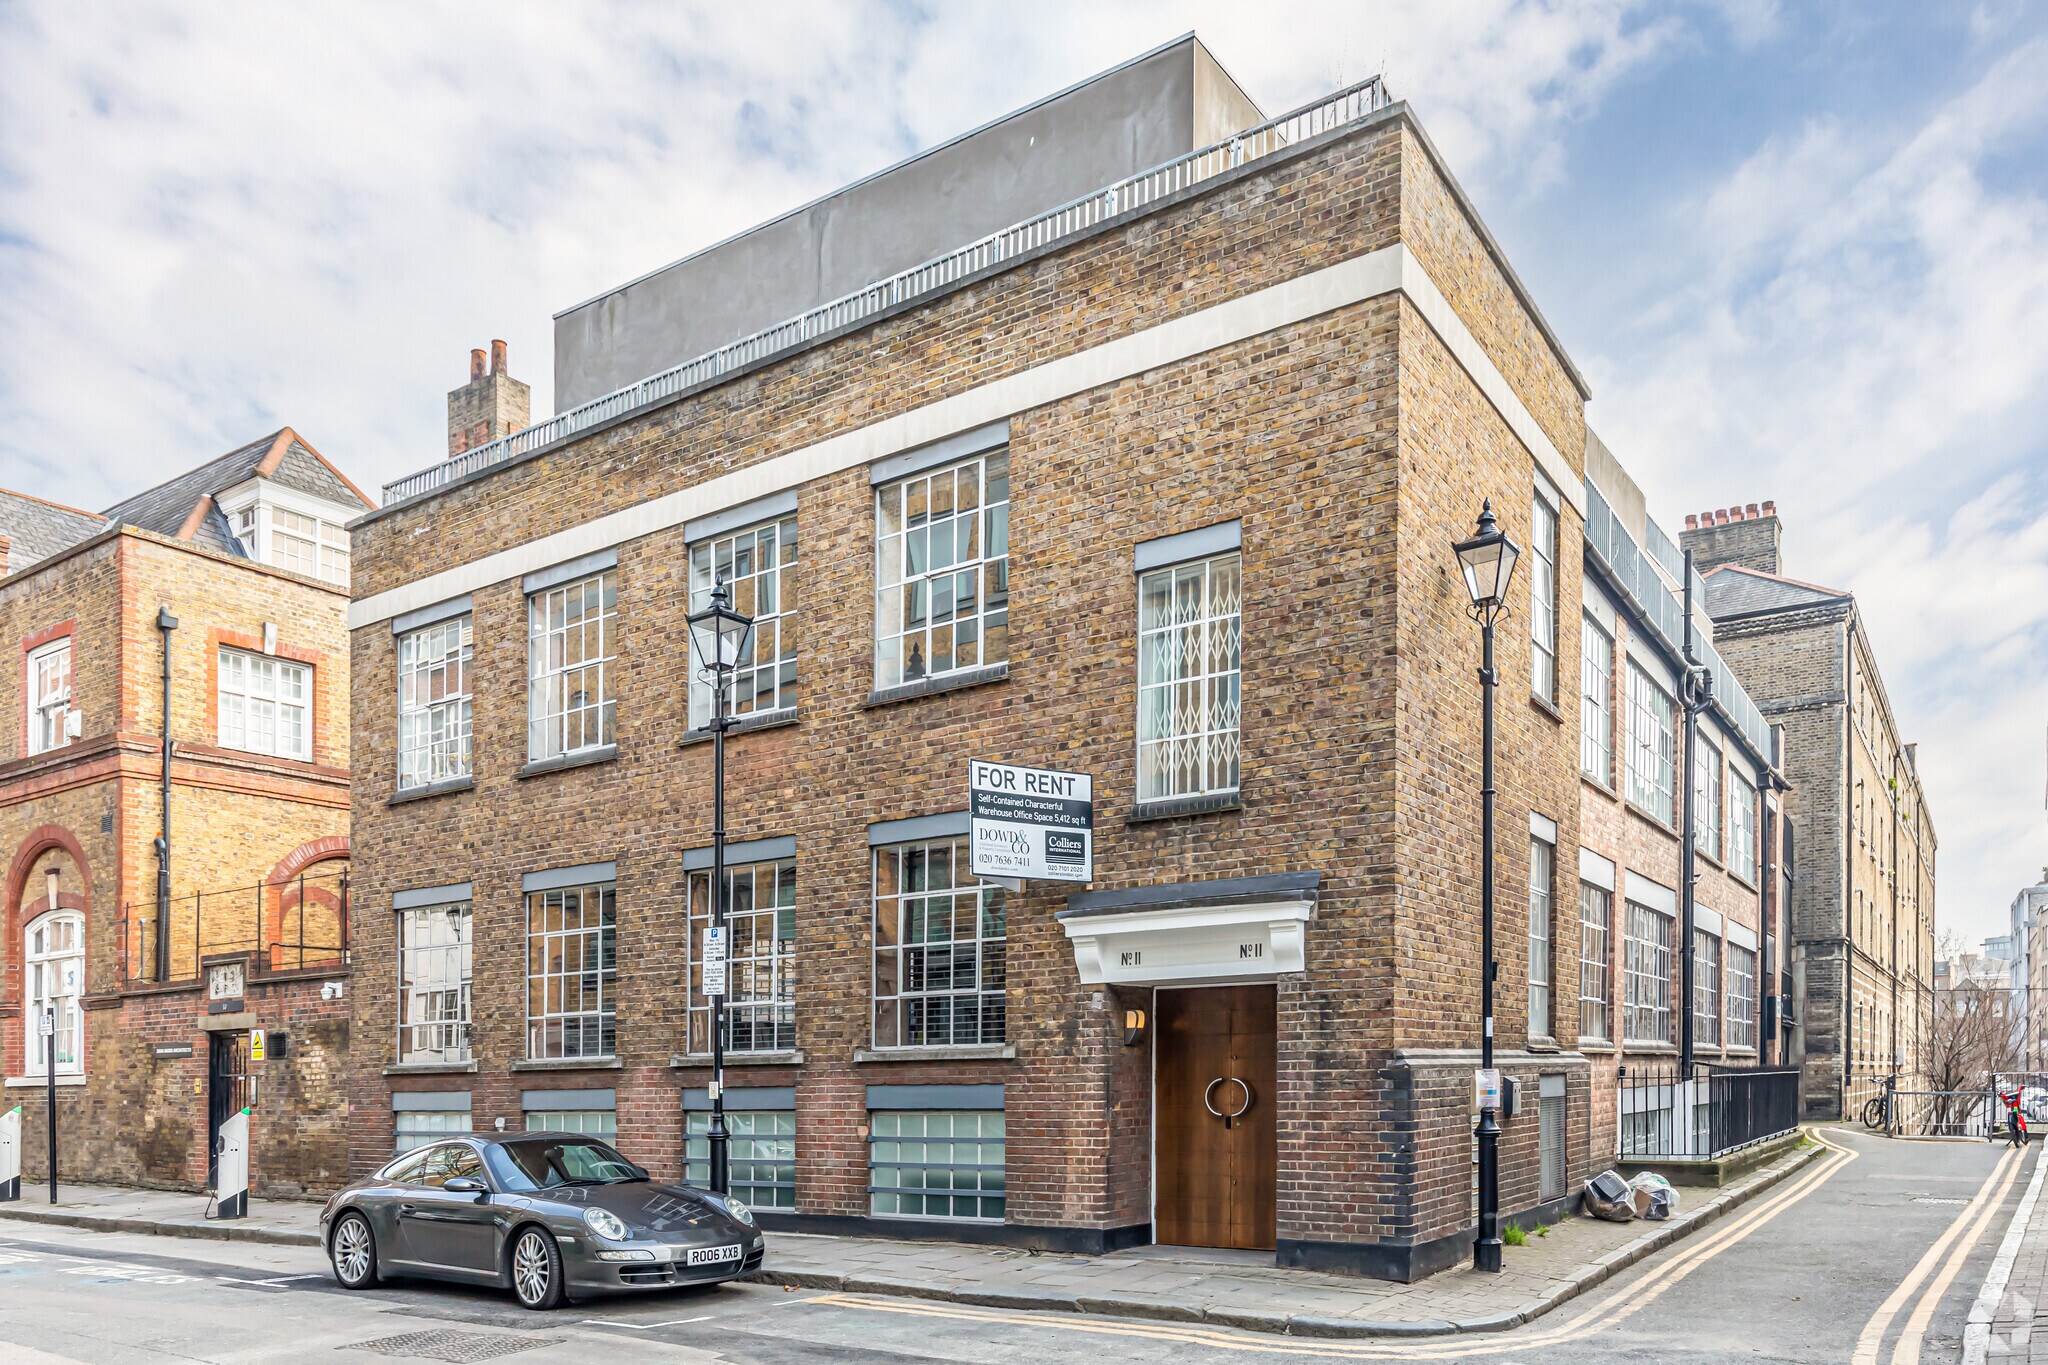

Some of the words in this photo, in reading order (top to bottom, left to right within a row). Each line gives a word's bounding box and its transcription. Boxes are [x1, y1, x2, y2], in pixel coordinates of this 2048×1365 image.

[978, 766, 1016, 790] FOR
[1025, 773, 1076, 796] RENT
[978, 794, 1024, 807] Self-Contained
[1025, 799, 1063, 811] Characterful
[978, 806, 1012, 818] Warehouse
[1013, 810, 1033, 820] Office
[1034, 813, 1054, 823] Space
[1054, 814, 1071, 824] 5,412
[1080, 816, 1086, 825] ft
[1048, 836, 1082, 849] Colliers
[978, 853, 993, 863] 020
[994, 855, 1012, 865] 7636
[1014, 857, 1030, 866] 7411
[722, 1247, 739, 1260] XXB
